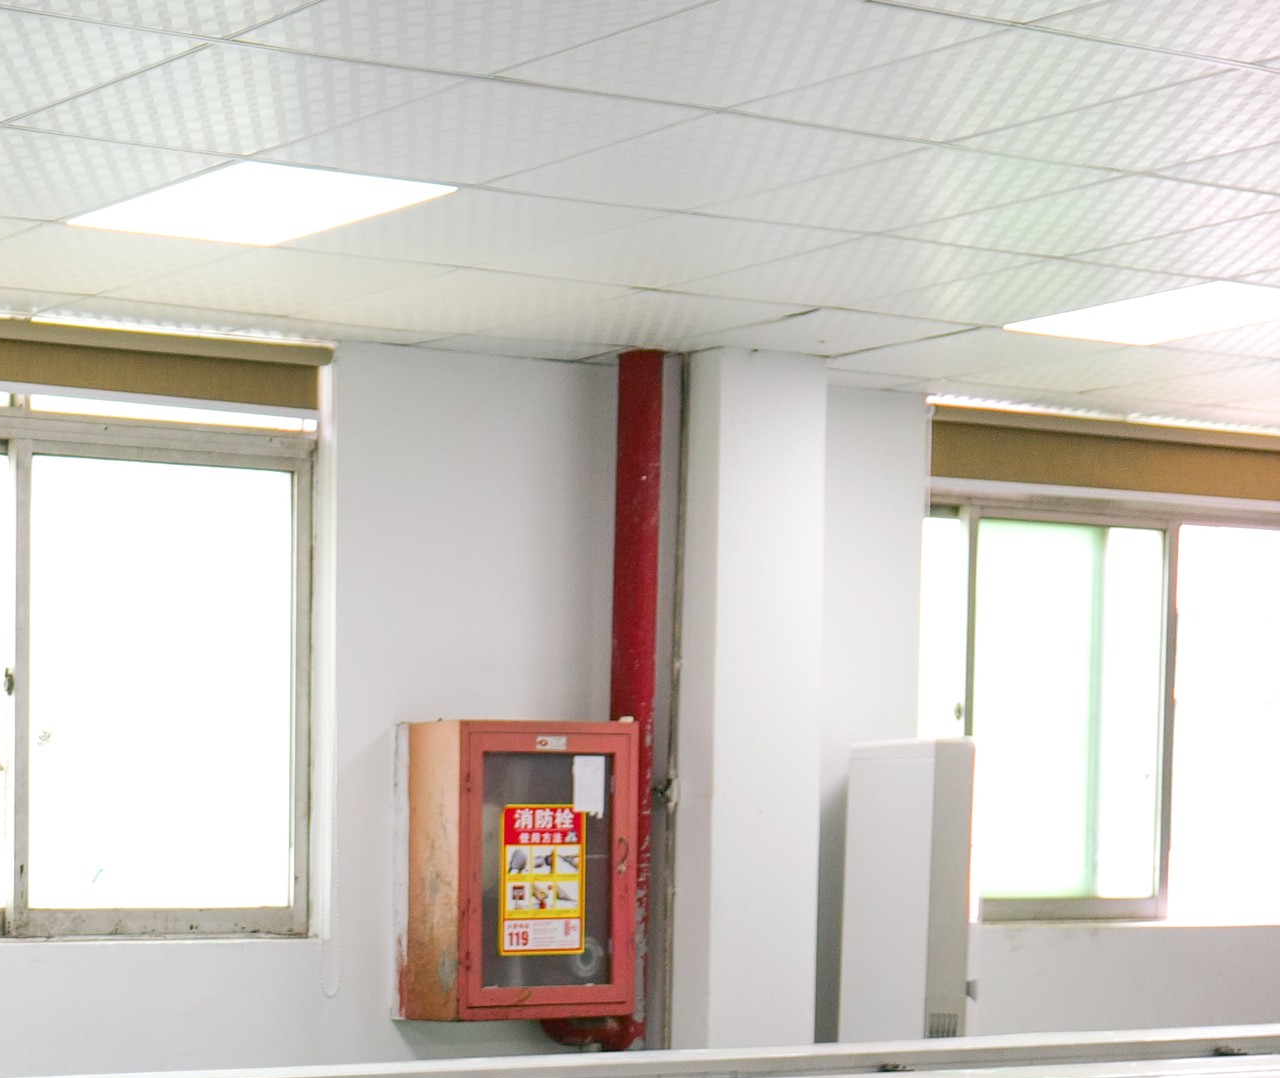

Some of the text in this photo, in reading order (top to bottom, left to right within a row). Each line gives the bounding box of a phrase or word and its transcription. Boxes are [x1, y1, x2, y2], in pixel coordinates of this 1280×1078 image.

[514, 808, 574, 828] 消防栓
[519, 832, 564, 844] 使用方法
[508, 931, 529, 946] 119
